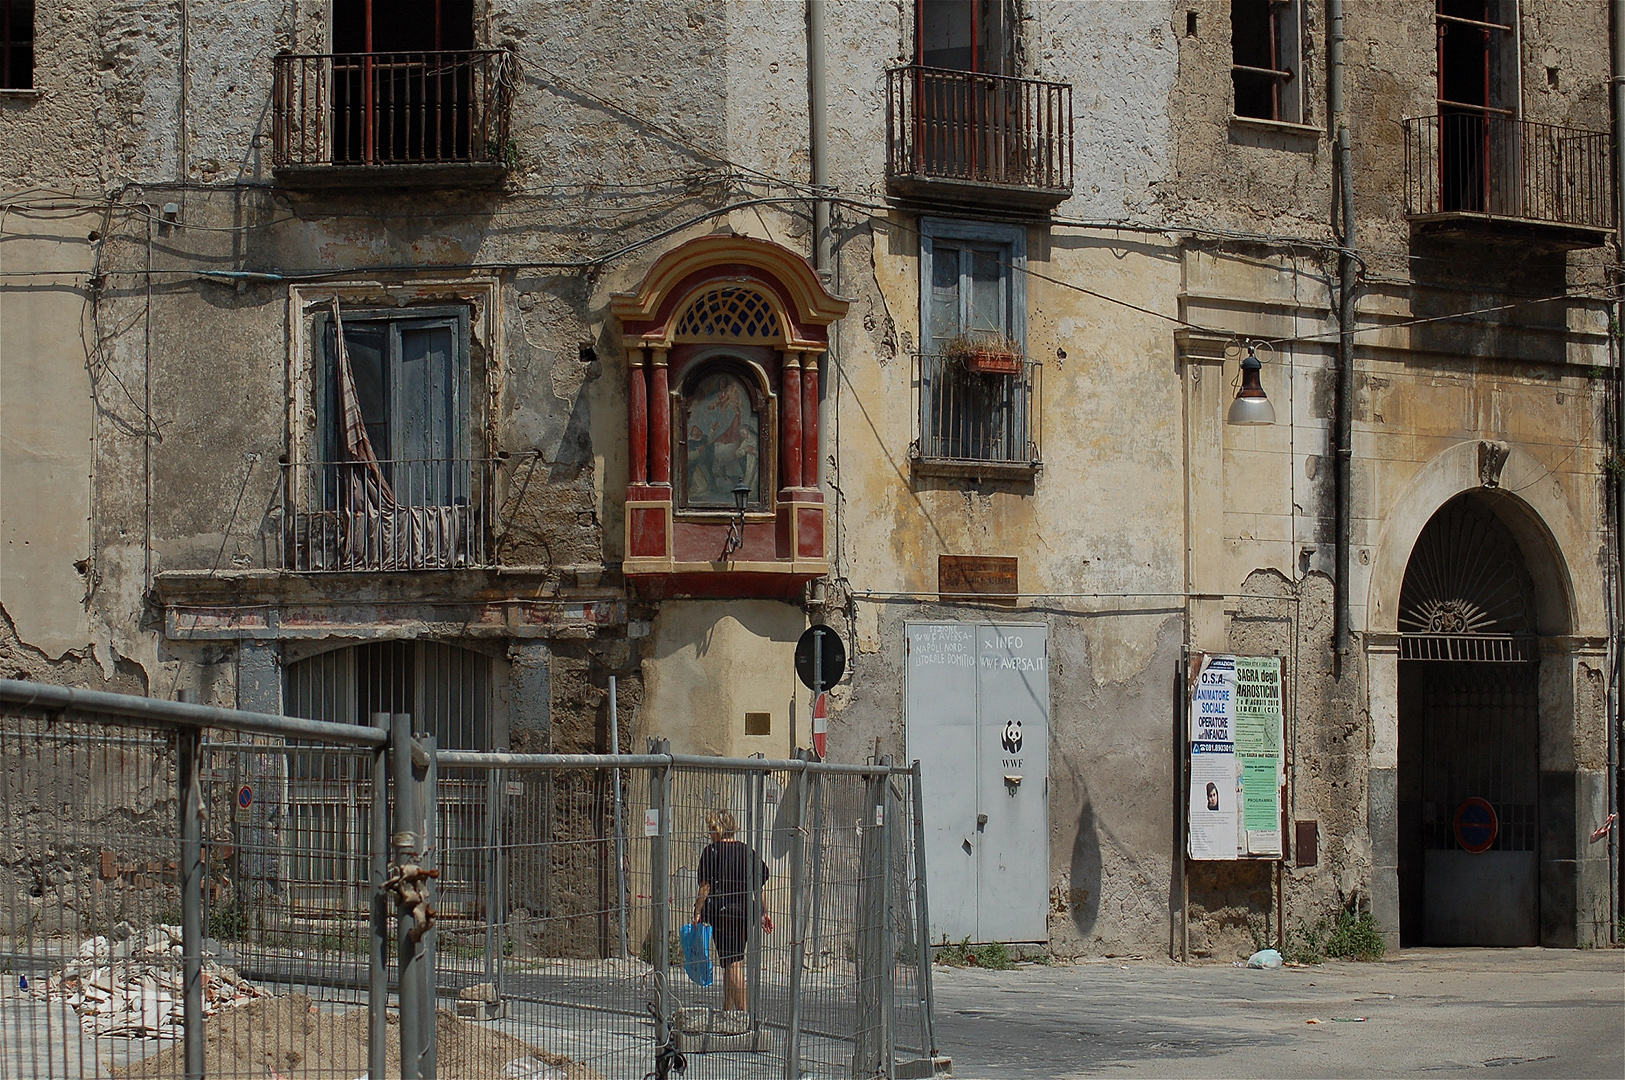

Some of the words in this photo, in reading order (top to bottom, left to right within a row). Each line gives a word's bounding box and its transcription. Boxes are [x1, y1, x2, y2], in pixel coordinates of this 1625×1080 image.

[929, 625, 957, 633] SEZIONE
[914, 632, 937, 643] WWF
[995, 635, 1024, 649] INFO
[1201, 672, 1226, 685] O.S.A.
[1237, 668, 1259, 682] SAGRA
[1260, 669, 1278, 685] degli
[1197, 690, 1230, 701] ANIMATORE
[1236, 684, 1279, 698] ARROSTICINI
[1201, 702, 1226, 714] SOCIALE
[1198, 716, 1229, 728] OPERATORE
[1002, 759, 1023, 769] WWF
